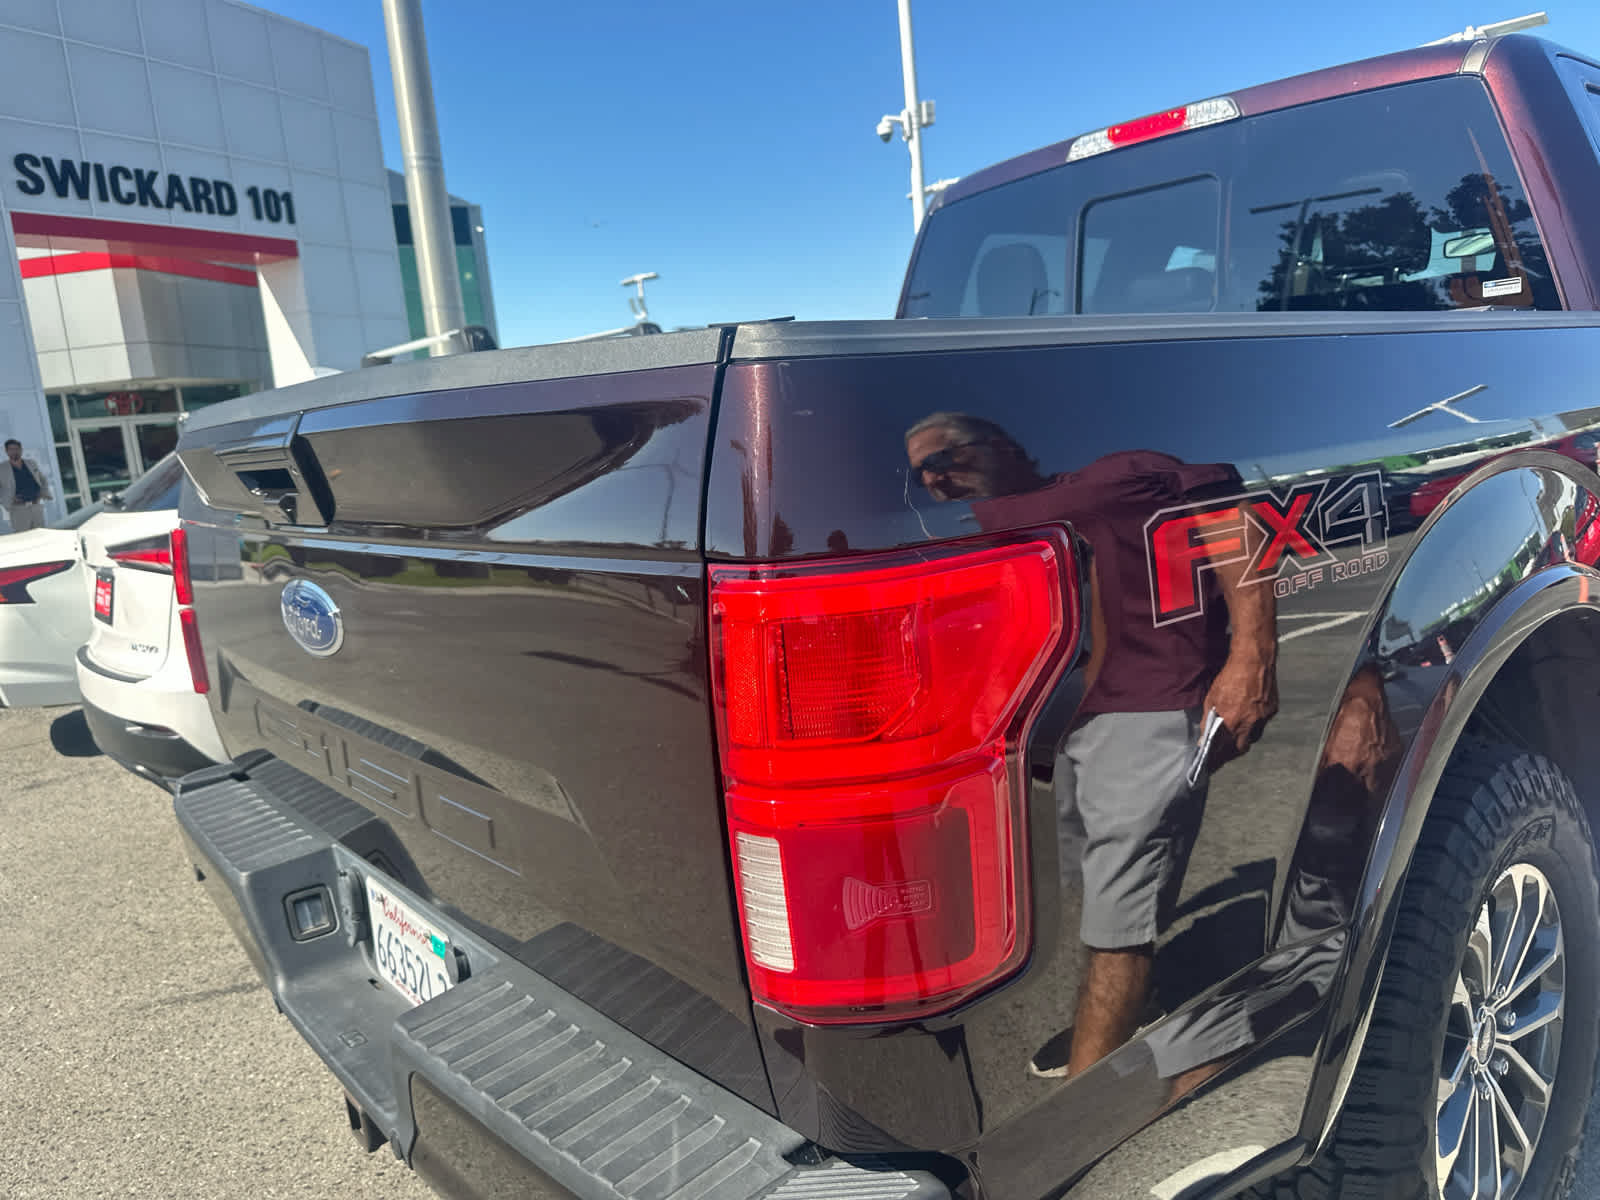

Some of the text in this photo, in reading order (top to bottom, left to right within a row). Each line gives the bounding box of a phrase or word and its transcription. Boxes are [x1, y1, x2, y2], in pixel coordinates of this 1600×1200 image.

[13, 153, 296, 225] SWICKARD 101
[1144, 469, 1389, 628] FX4
[1274, 550, 1390, 598] OFF ROAD
[284, 596, 323, 642] Ford
